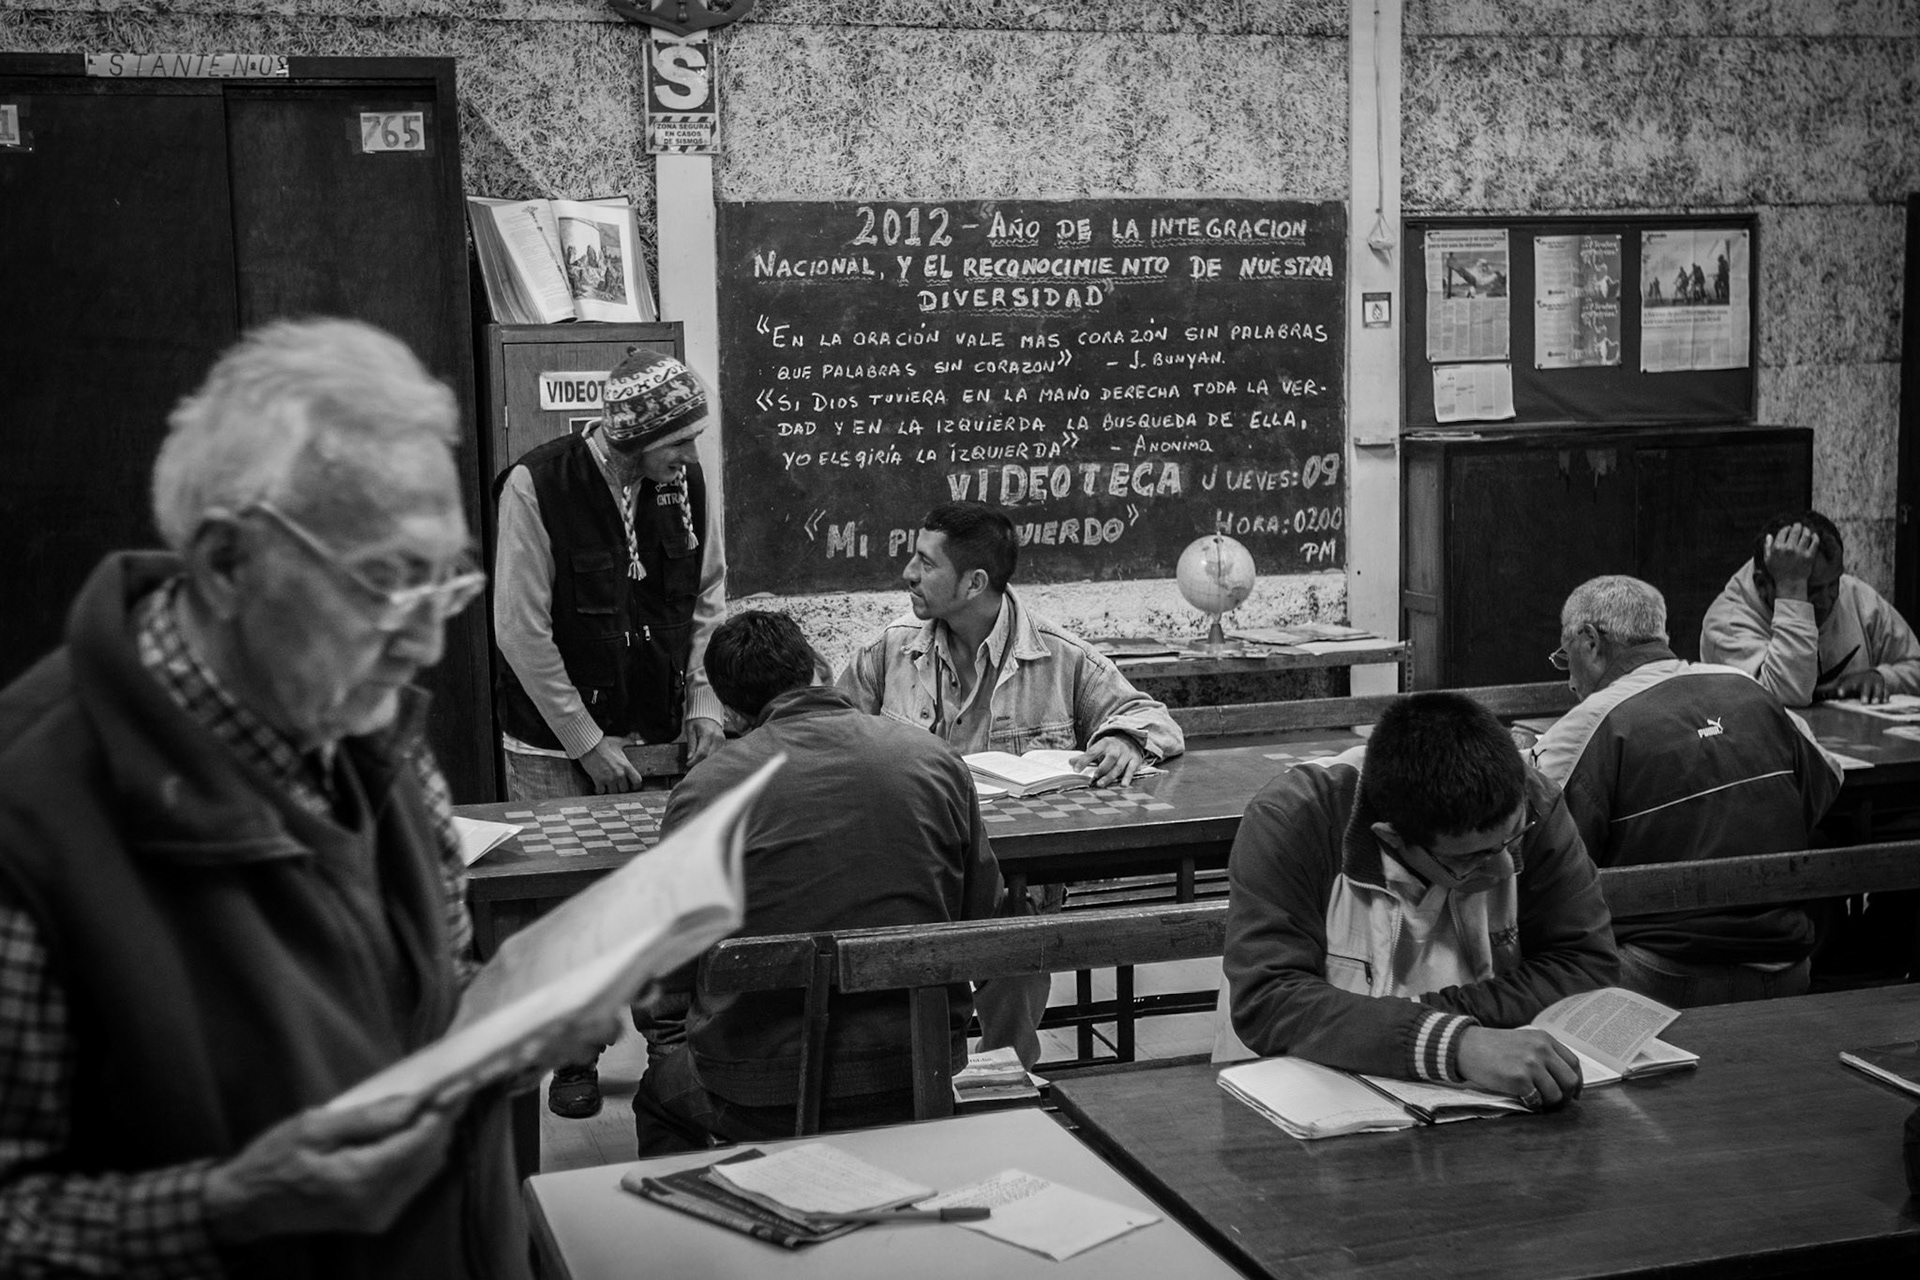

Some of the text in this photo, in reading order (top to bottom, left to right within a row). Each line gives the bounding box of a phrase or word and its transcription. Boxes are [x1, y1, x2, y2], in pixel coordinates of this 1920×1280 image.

[655, 45, 709, 110] S
[362, 115, 421, 148] 765
[852, 206, 952, 247] 2012
[1056, 218, 1091, 241] DE
[1112, 217, 1140, 239] LA
[1151, 217, 1307, 240] INTEGRACION
[754, 250, 1333, 281] NACIONAL, Y EL RECONOCIMIENTO DE NUESTRA
[820, 333, 842, 347] LA
[956, 332, 1005, 347] VALE
[1021, 333, 1060, 348] MAS
[1185, 325, 1218, 341] SIN
[1231, 323, 1328, 342] PALABRAS
[777, 366, 811, 380] QUE
[822, 363, 917, 379] PALABRAS
[934, 359, 962, 373] SIN
[1153, 351, 1225, 370] BUNYAN.
[546, 380, 606, 403] VIDEOT
[811, 392, 858, 412] DIOS
[963, 388, 990, 403] EN
[1004, 387, 1027, 403] LA
[1039, 384, 1089, 403] MANO
[1100, 385, 1180, 400] DERECHA
[1193, 380, 1237, 396] TODA
[1248, 379, 1268, 396] LA
[778, 421, 816, 436] DAD
[835, 421, 844, 436] Y
[853, 419, 882, 434] EN
[898, 419, 924, 435] LA
[937, 415, 1046, 433] IZQUIERDA
[1067, 416, 1089, 431] LA
[1102, 413, 1197, 431] BUSQUEDA
[1207, 411, 1233, 427] DE
[783, 451, 811, 470] YO
[916, 449, 937, 464] LA
[1202, 453, 1339, 490] JUEVES: 09
[947, 462, 1181, 504] VIDEOTECA
[889, 528, 916, 557] PI
[1300, 538, 1336, 562] PM
